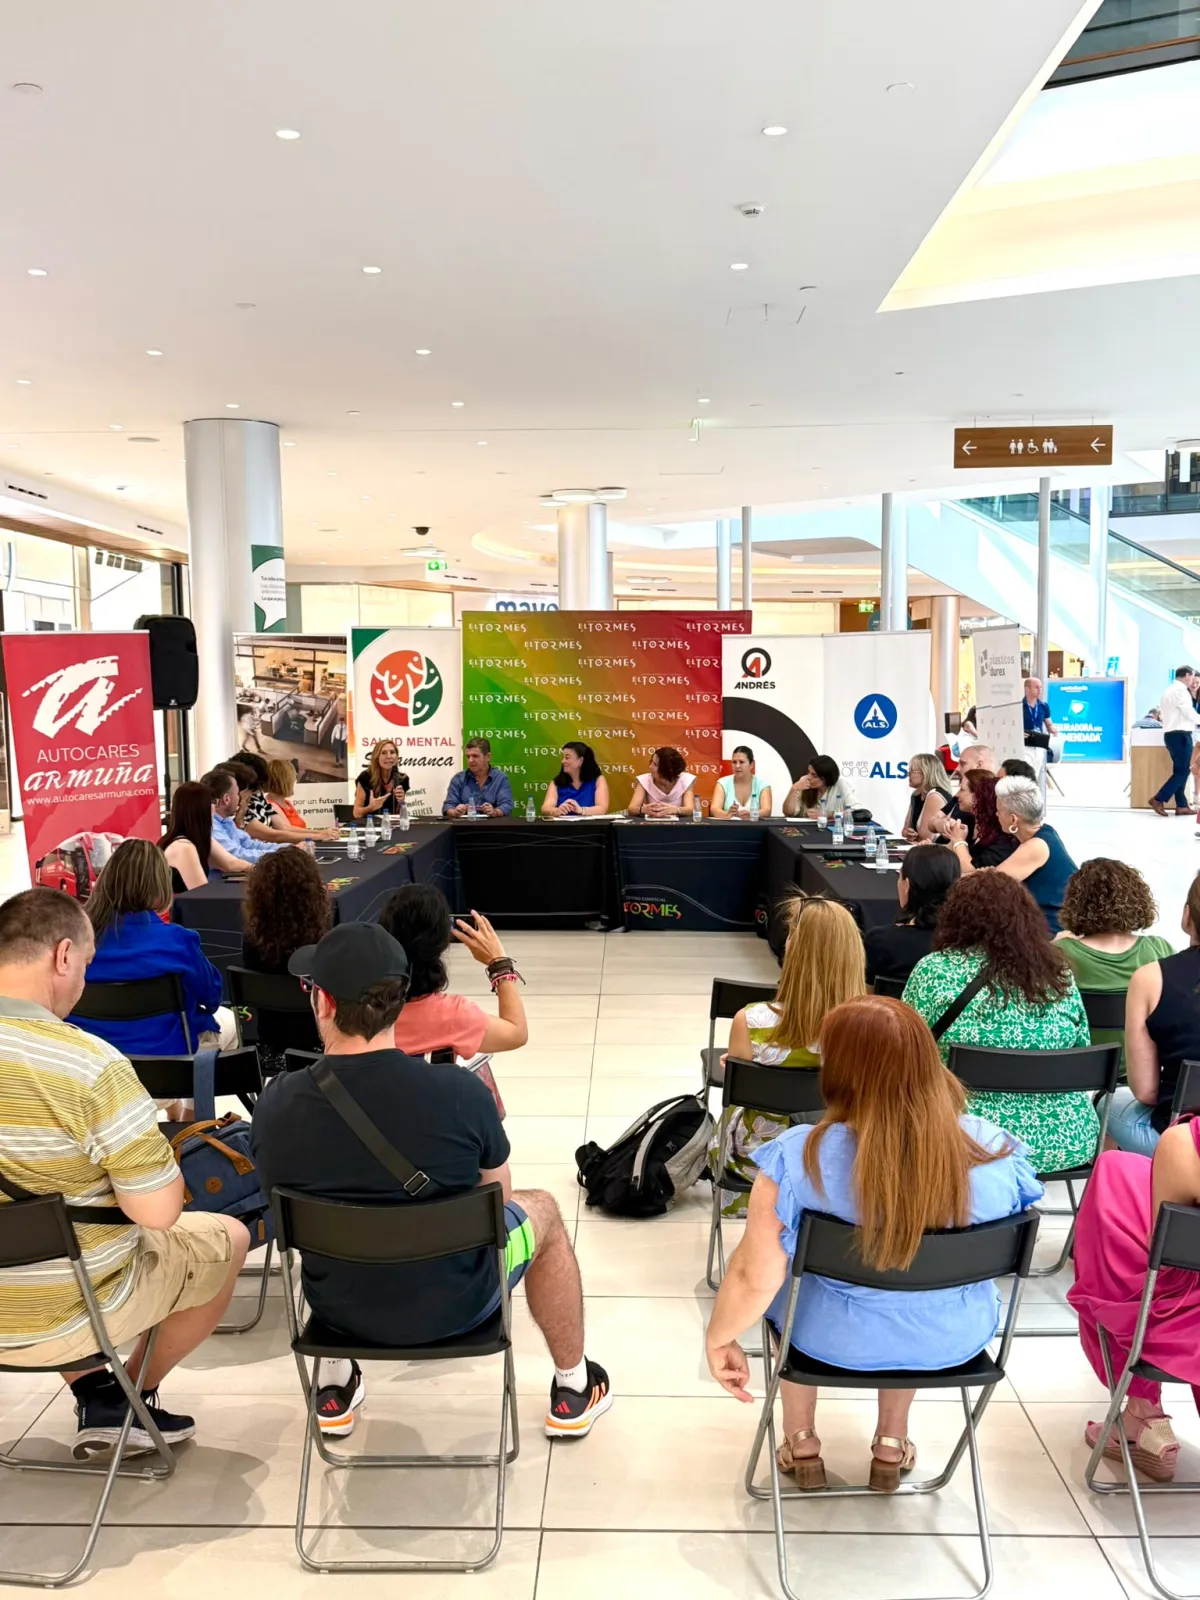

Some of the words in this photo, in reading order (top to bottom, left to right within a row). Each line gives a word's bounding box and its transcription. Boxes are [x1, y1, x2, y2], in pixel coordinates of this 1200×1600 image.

[362, 737, 403, 746] SAD
[407, 737, 455, 746] MENTAL
[37, 744, 140, 763] AUTOCARES
[362, 752, 454, 768] Samanca
[842, 767, 868, 777] one
[869, 762, 908, 779] ALS
[27, 788, 154, 805] www.autocaresarmuna.com
